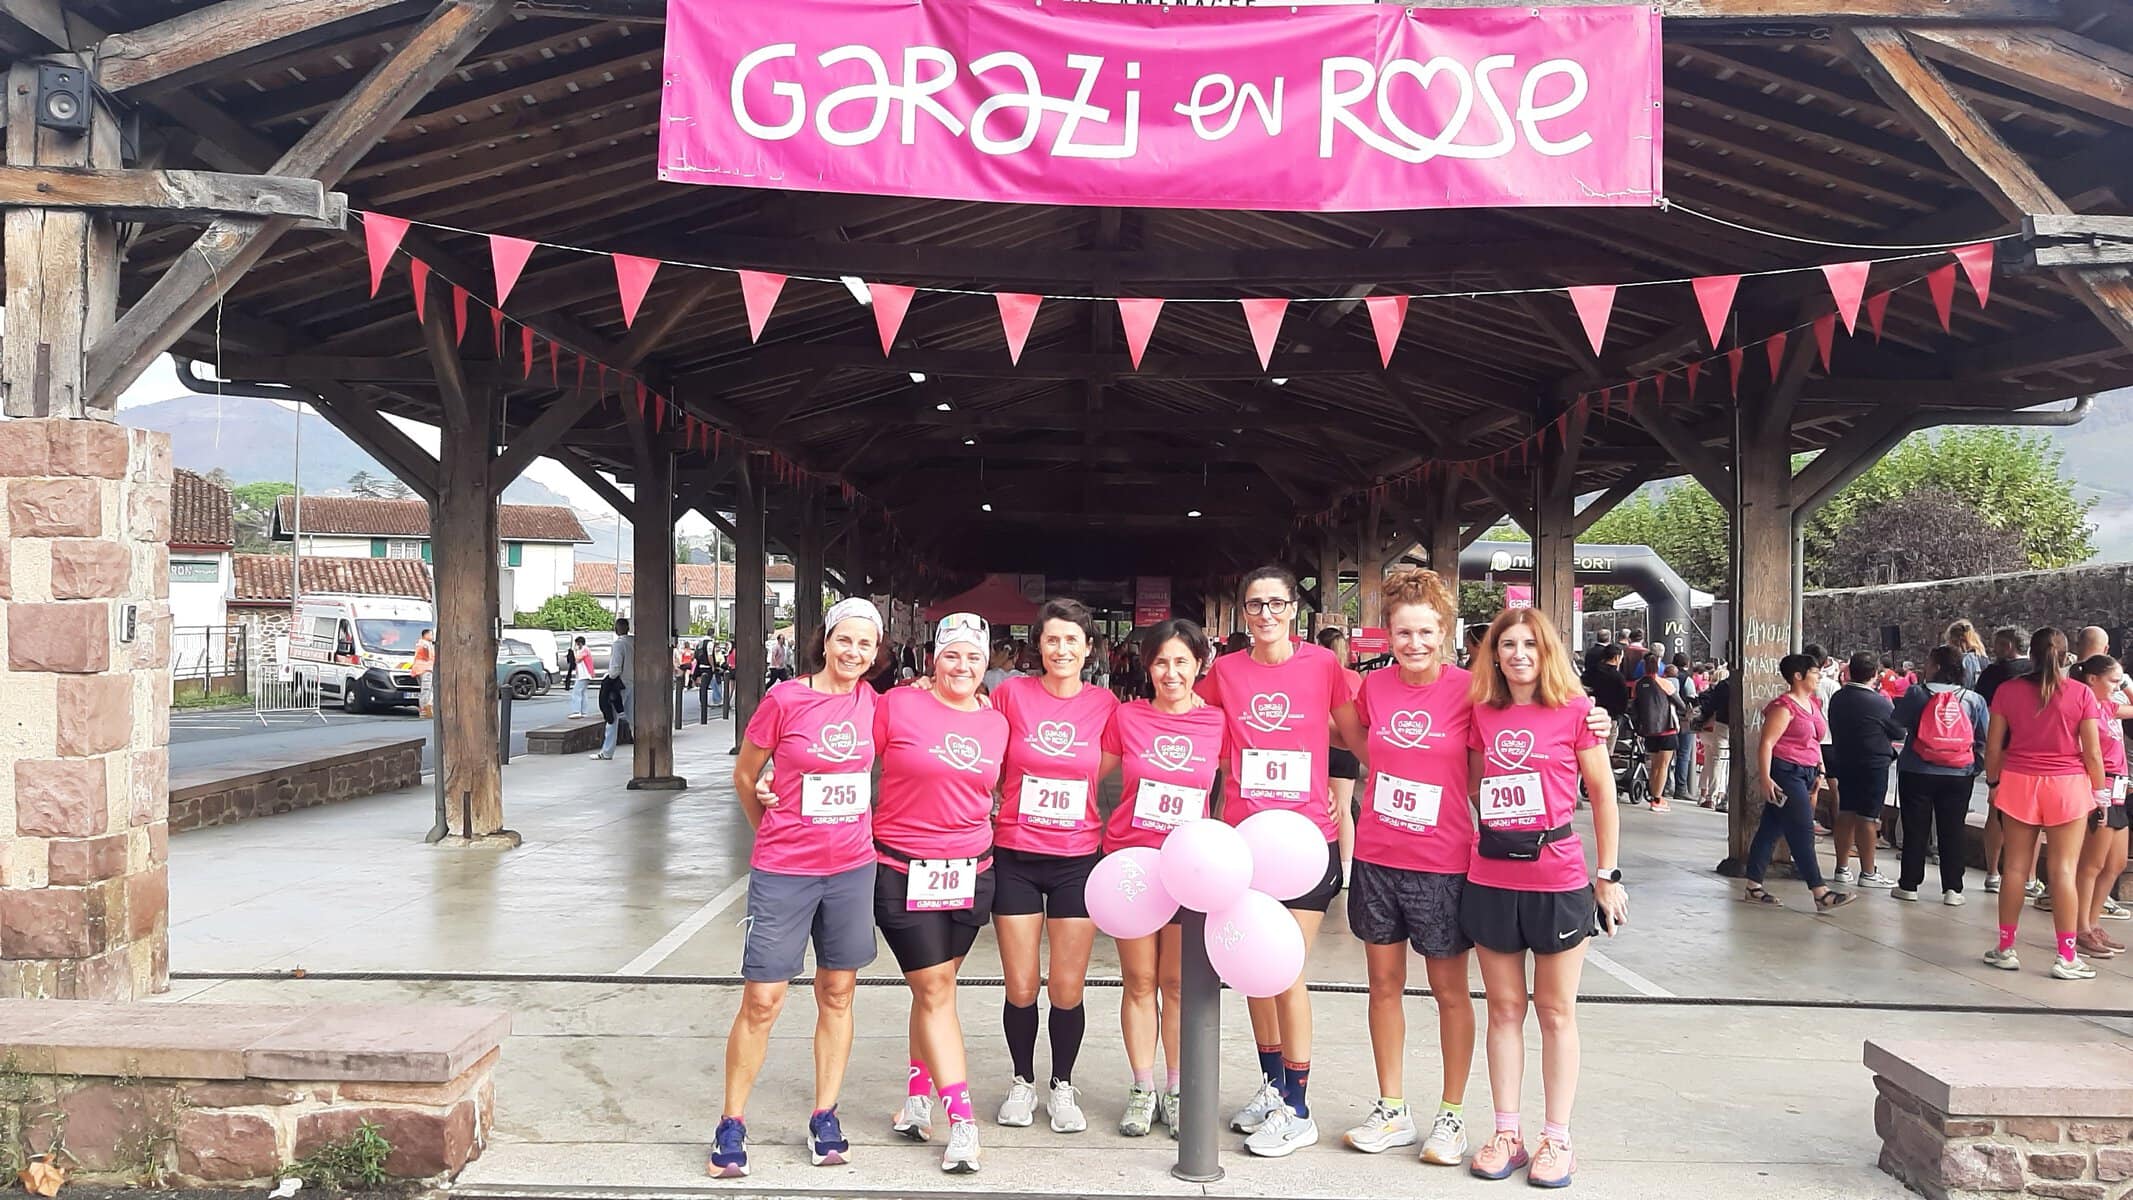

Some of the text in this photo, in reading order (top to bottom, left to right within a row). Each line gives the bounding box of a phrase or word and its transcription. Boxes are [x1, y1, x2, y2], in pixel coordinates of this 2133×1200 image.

[1266, 761, 1287, 780] 61
[821, 785, 857, 806] 255
[1038, 788, 1070, 810] 216
[1158, 794, 1184, 815] 89
[1392, 788, 1417, 812] 95
[1491, 786, 1526, 808] 290
[928, 870, 960, 890] 218
